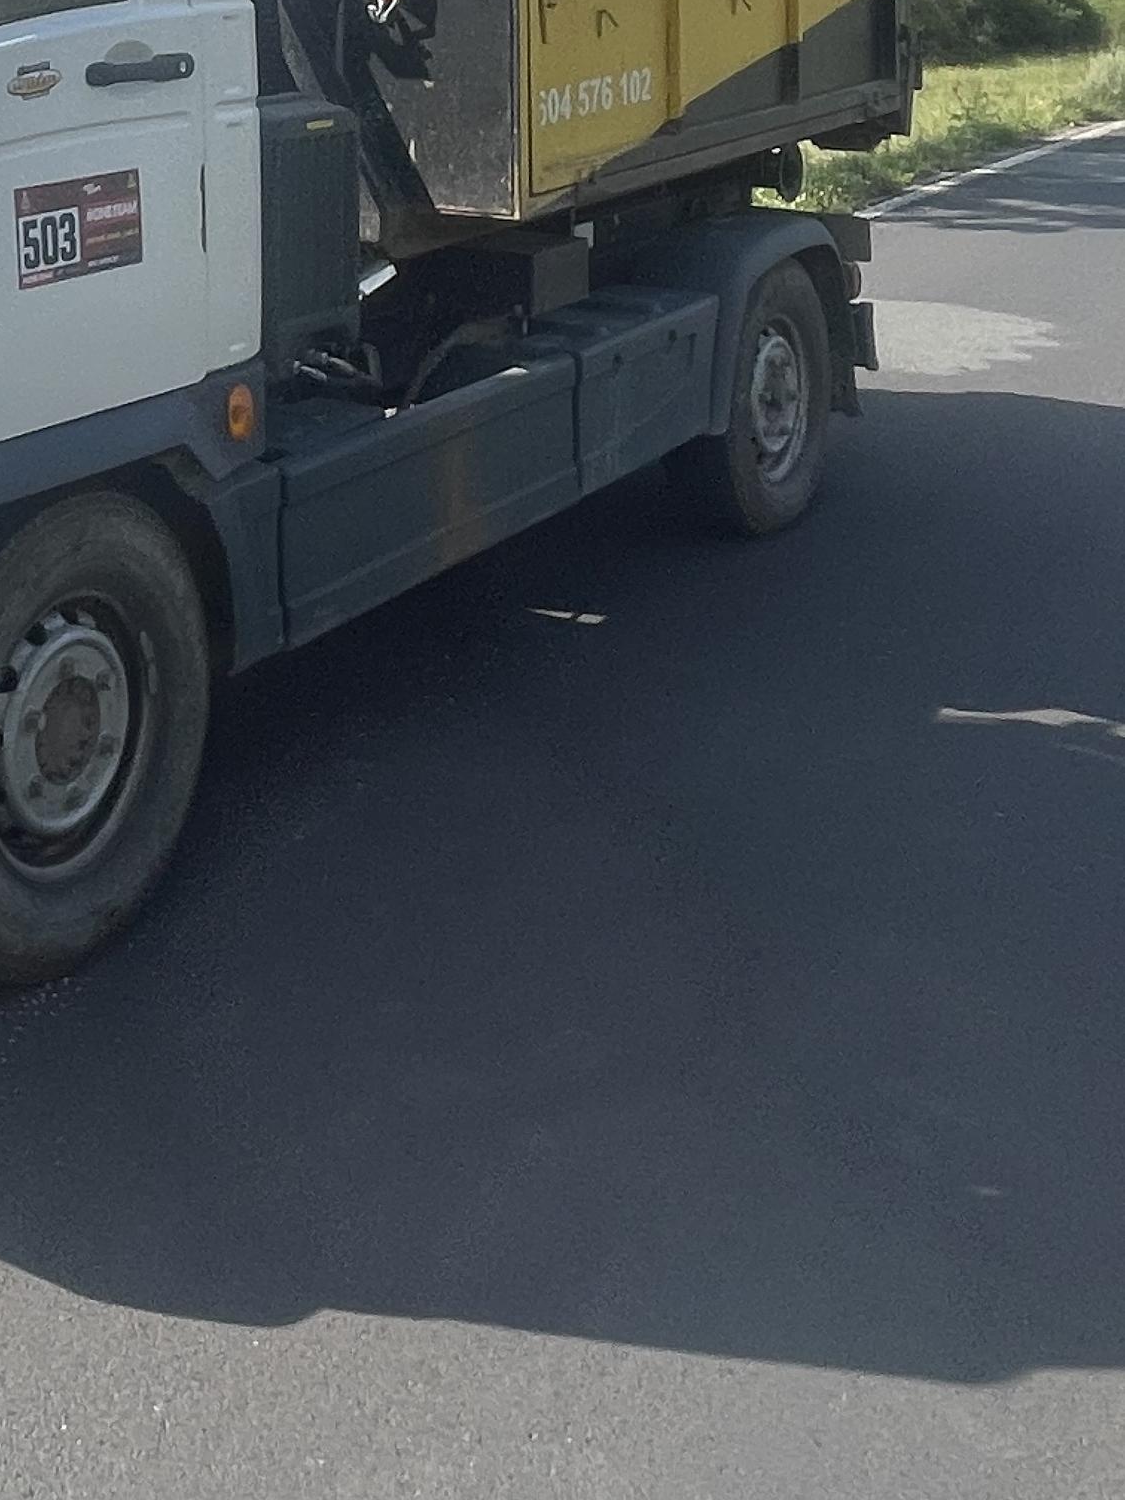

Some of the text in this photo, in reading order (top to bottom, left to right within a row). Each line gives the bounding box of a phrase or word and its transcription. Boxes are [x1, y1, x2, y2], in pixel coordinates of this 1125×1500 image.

[577, 75, 613, 117] 576
[619, 67, 652, 106] 102
[22, 211, 77, 270] 503
